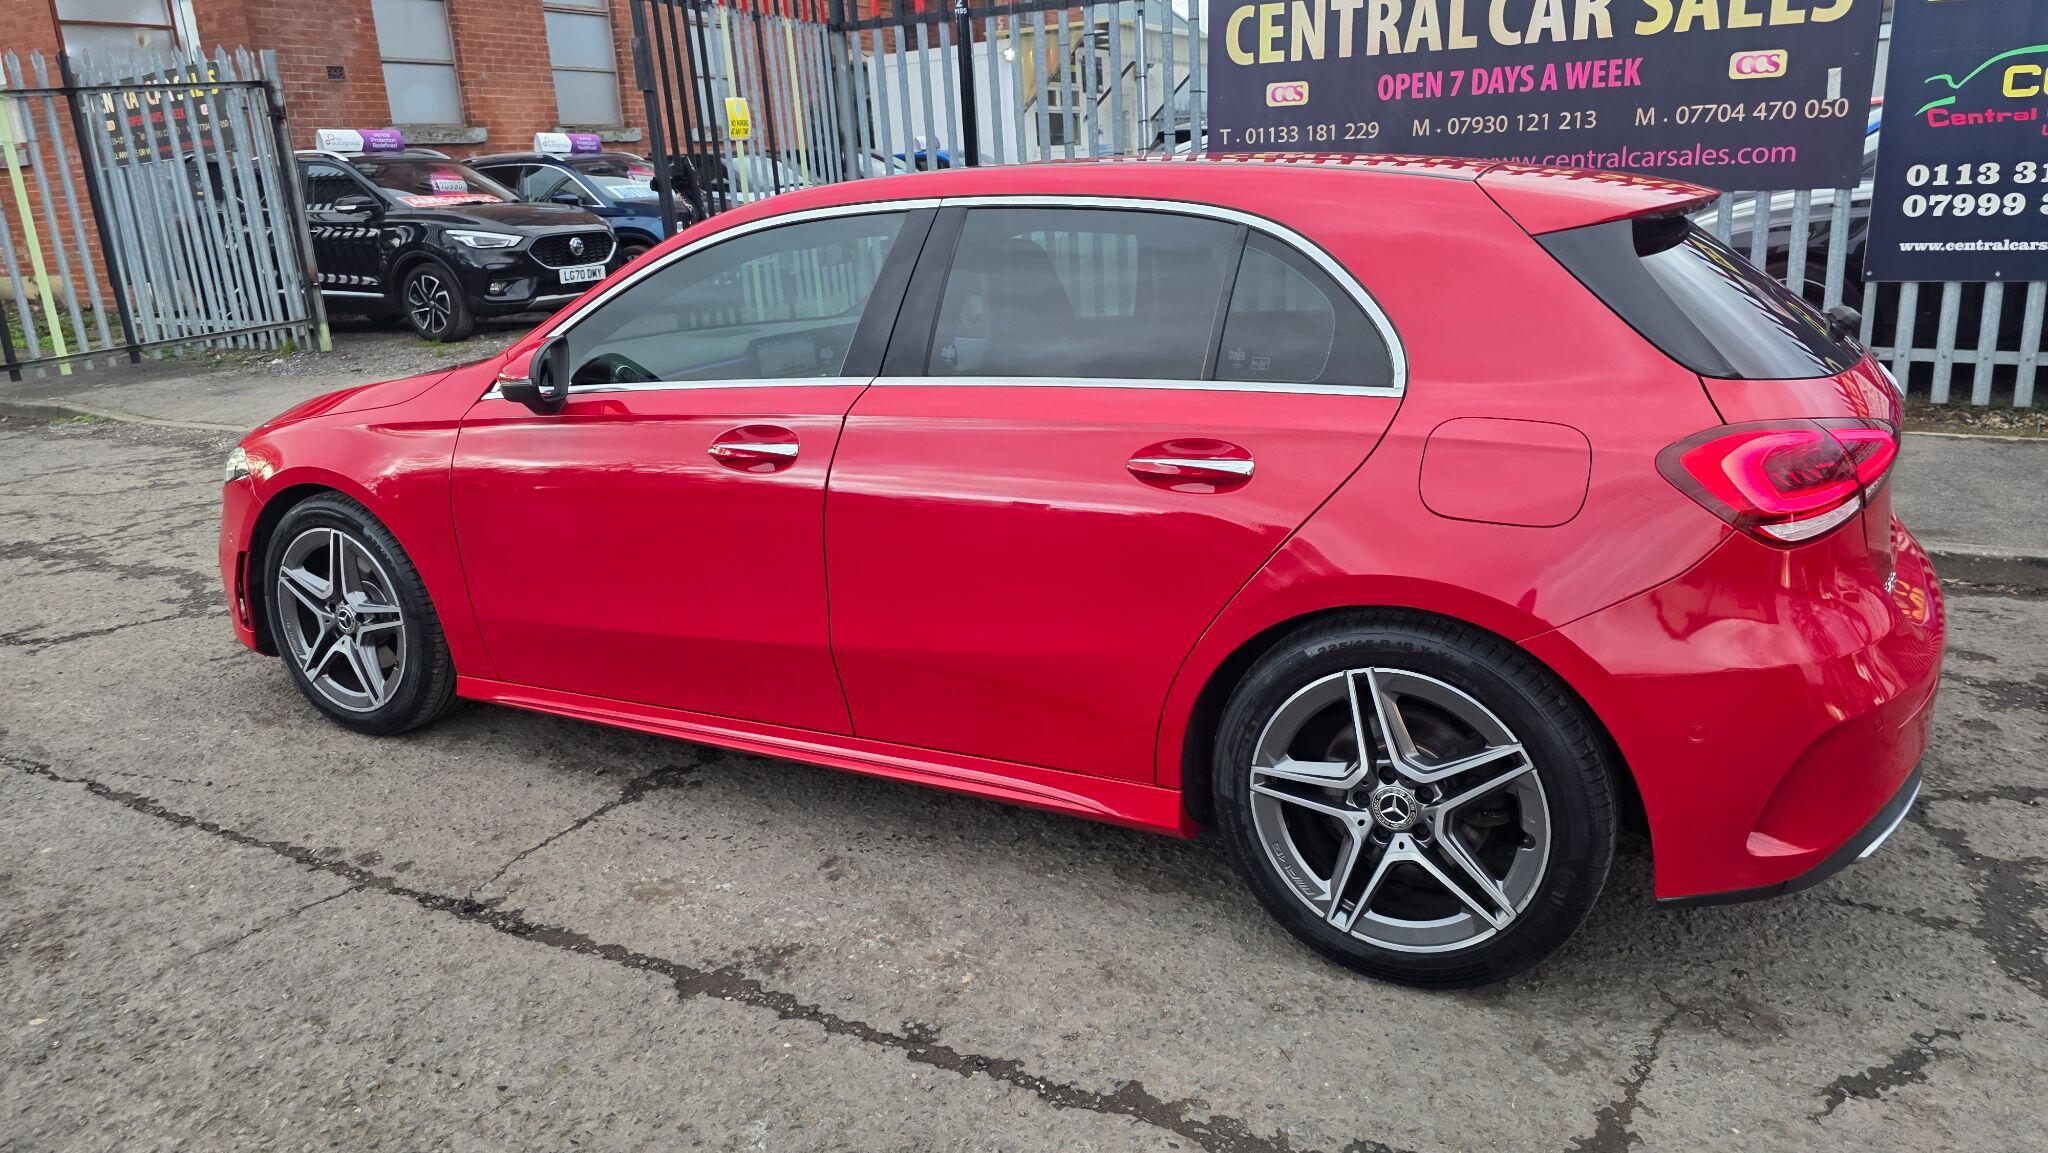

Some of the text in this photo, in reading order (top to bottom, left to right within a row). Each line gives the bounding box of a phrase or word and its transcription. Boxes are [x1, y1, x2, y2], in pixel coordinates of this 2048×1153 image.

[1225, 0, 1478, 66] CENTRAL
[1488, 0, 1614, 46] CAR
[1377, 57, 1643, 101] OPEN 7 DAYS A WEEK
[2002, 64, 2048, 98] C
[1412, 110, 1598, 137] M 07930 121 213
[1634, 97, 1850, 127] M 07704 470 050
[1926, 107, 2038, 128] Central
[1219, 121, 1380, 145] T 01133 181 229
[1906, 162, 2001, 187] 0113
[1902, 192, 2027, 218] 07999
[563, 269, 586, 281] LG70
